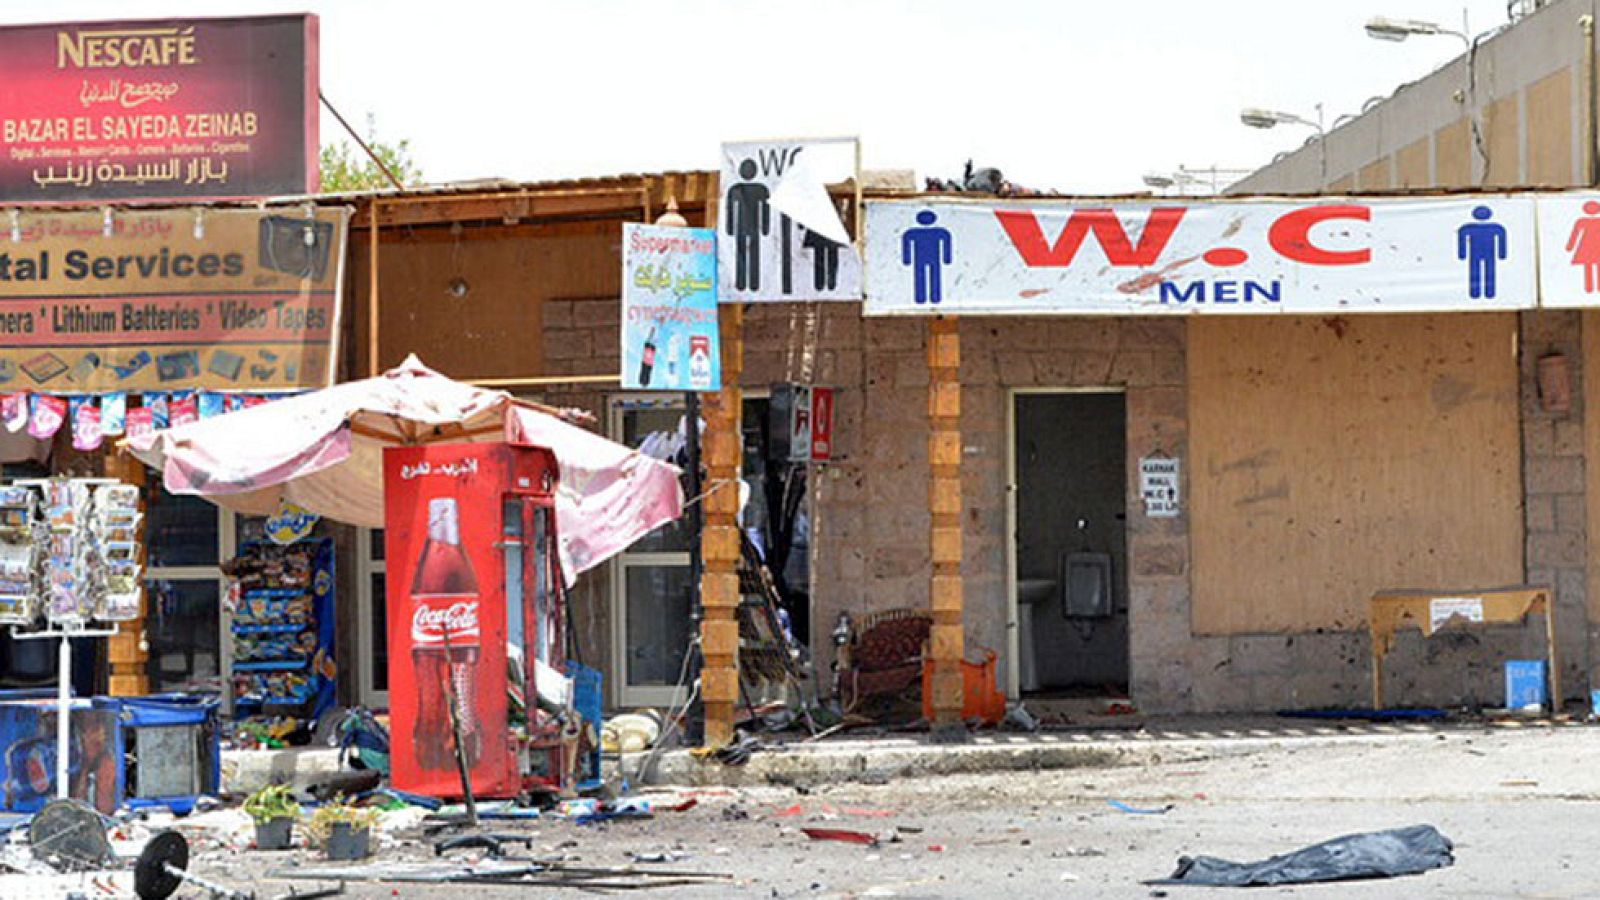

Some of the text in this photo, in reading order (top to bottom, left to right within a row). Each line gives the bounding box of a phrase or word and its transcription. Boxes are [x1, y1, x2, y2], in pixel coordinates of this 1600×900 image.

[57, 26, 196, 68] NESCAFÉ
[4, 112, 258, 143] BAZAR EL SAYEDA ZEINAB
[33, 158, 227, 188] بازار السيدة زينب
[993, 205, 1371, 267] W.C
[64, 247, 243, 281] Services
[1159, 280, 1281, 303] MEN
[52, 304, 116, 334] Lithium
[122, 302, 200, 332] Batteries
[219, 300, 267, 331] Video
[273, 299, 326, 336] Tapes
